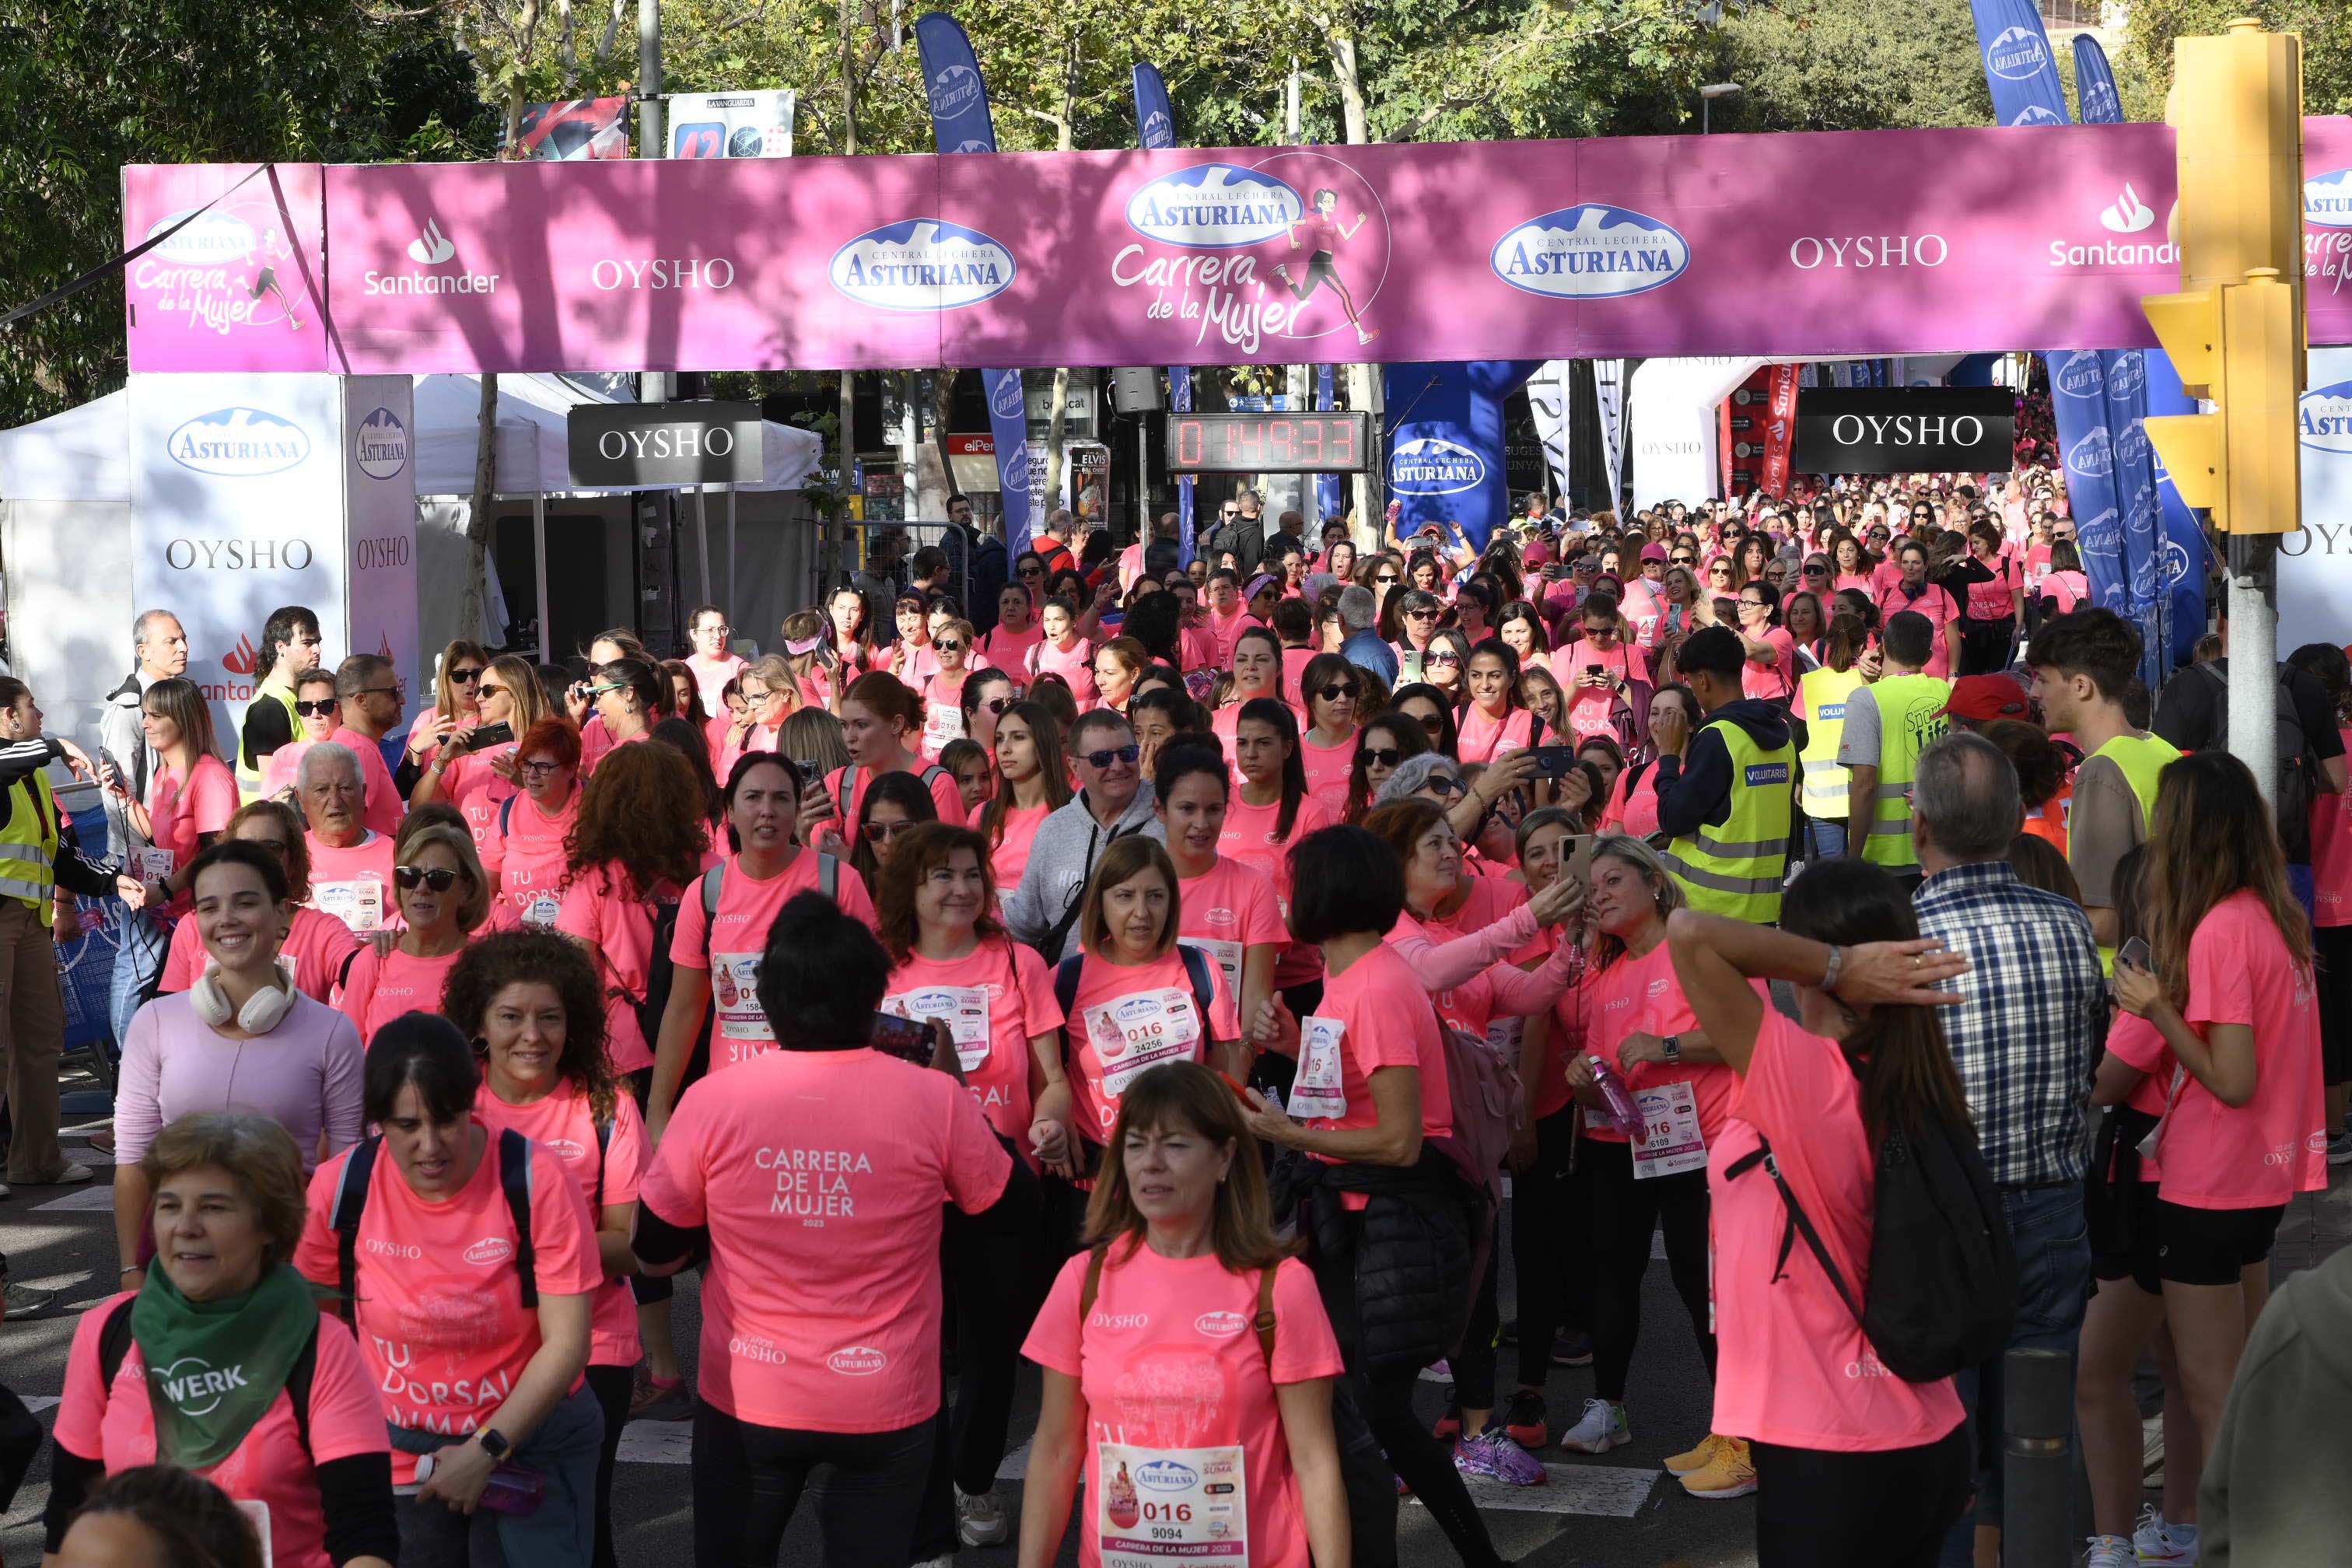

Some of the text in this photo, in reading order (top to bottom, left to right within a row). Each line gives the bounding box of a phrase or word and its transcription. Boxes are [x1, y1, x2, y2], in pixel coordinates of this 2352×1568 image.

[1228, 191, 1284, 200] LECHERA
[1140, 197, 1289, 227] ASTURIANA
[1538, 235, 1667, 247] CENTRAL LECHERA
[872, 250, 931, 259] CENTRAL
[1507, 241, 1674, 275] ASTURIANA
[1790, 235, 1948, 269] OYSHO
[135, 261, 226, 289] Carrera
[591, 258, 734, 289] OYSHO
[845, 254, 1001, 286] ASTURIANA
[1111, 244, 1257, 287] Carrera
[2322, 254, 2336, 276] la
[365, 270, 499, 295] Santander
[158, 285, 261, 334] de la Mujer
[1147, 282, 1311, 355] de la Mujer
[1775, 363, 1792, 418] Santa
[1833, 415, 1983, 446] OYSHO
[179, 433, 299, 460] ASTURIANA
[359, 436, 404, 463] ASTURIANA
[598, 428, 733, 460] OYSHO
[1642, 442, 1701, 454] OYSHO
[1082, 455, 1106, 464] ELVIS
[1390, 462, 1478, 482] ASTURIANA
[166, 539, 313, 570] OYSHO
[357, 535, 409, 570] OYSHO
[199, 679, 259, 701] anta
[1577, 705, 1593, 715] TU
[1907, 704, 1941, 732] Sport
[940, 722, 956, 730] 016
[469, 807, 488, 821] TU
[511, 870, 531, 885] TU
[714, 915, 750, 923] OYSHO
[379, 987, 413, 996] OYSHO
[1120, 1004, 1158, 1019] ASTURIANA
[726, 1025, 748, 1034] OYSHO
[1129, 1022, 1163, 1041] 016
[1135, 1039, 1162, 1053] 24256
[1113, 1059, 1139, 1072] CARRERA
[1160, 1047, 1179, 1057] MUJER
[755, 1147, 873, 1173] CARRERA
[1674, 1156, 1701, 1166] Santander
[777, 1171, 849, 1194] DE LA
[770, 1192, 854, 1216] MUJER
[803, 1219, 824, 1227] 2023
[366, 1239, 422, 1259] OYSHO
[468, 1245, 513, 1260] ASTURIANA
[1093, 1313, 1148, 1328] OYSHO
[1202, 1320, 1244, 1332] ASTURIANA
[373, 1335, 411, 1368] TU
[730, 1338, 786, 1364] OYSHO
[834, 1356, 883, 1368] ASTURIANA
[162, 1364, 249, 1403] WERK
[1140, 1471, 1193, 1484] ASTURIANA
[1204, 1466, 1232, 1475] SUMA
[1143, 1503, 1192, 1521] 016
[1152, 1528, 1182, 1539] 9094
[1115, 1541, 1150, 1552] CARRERA
